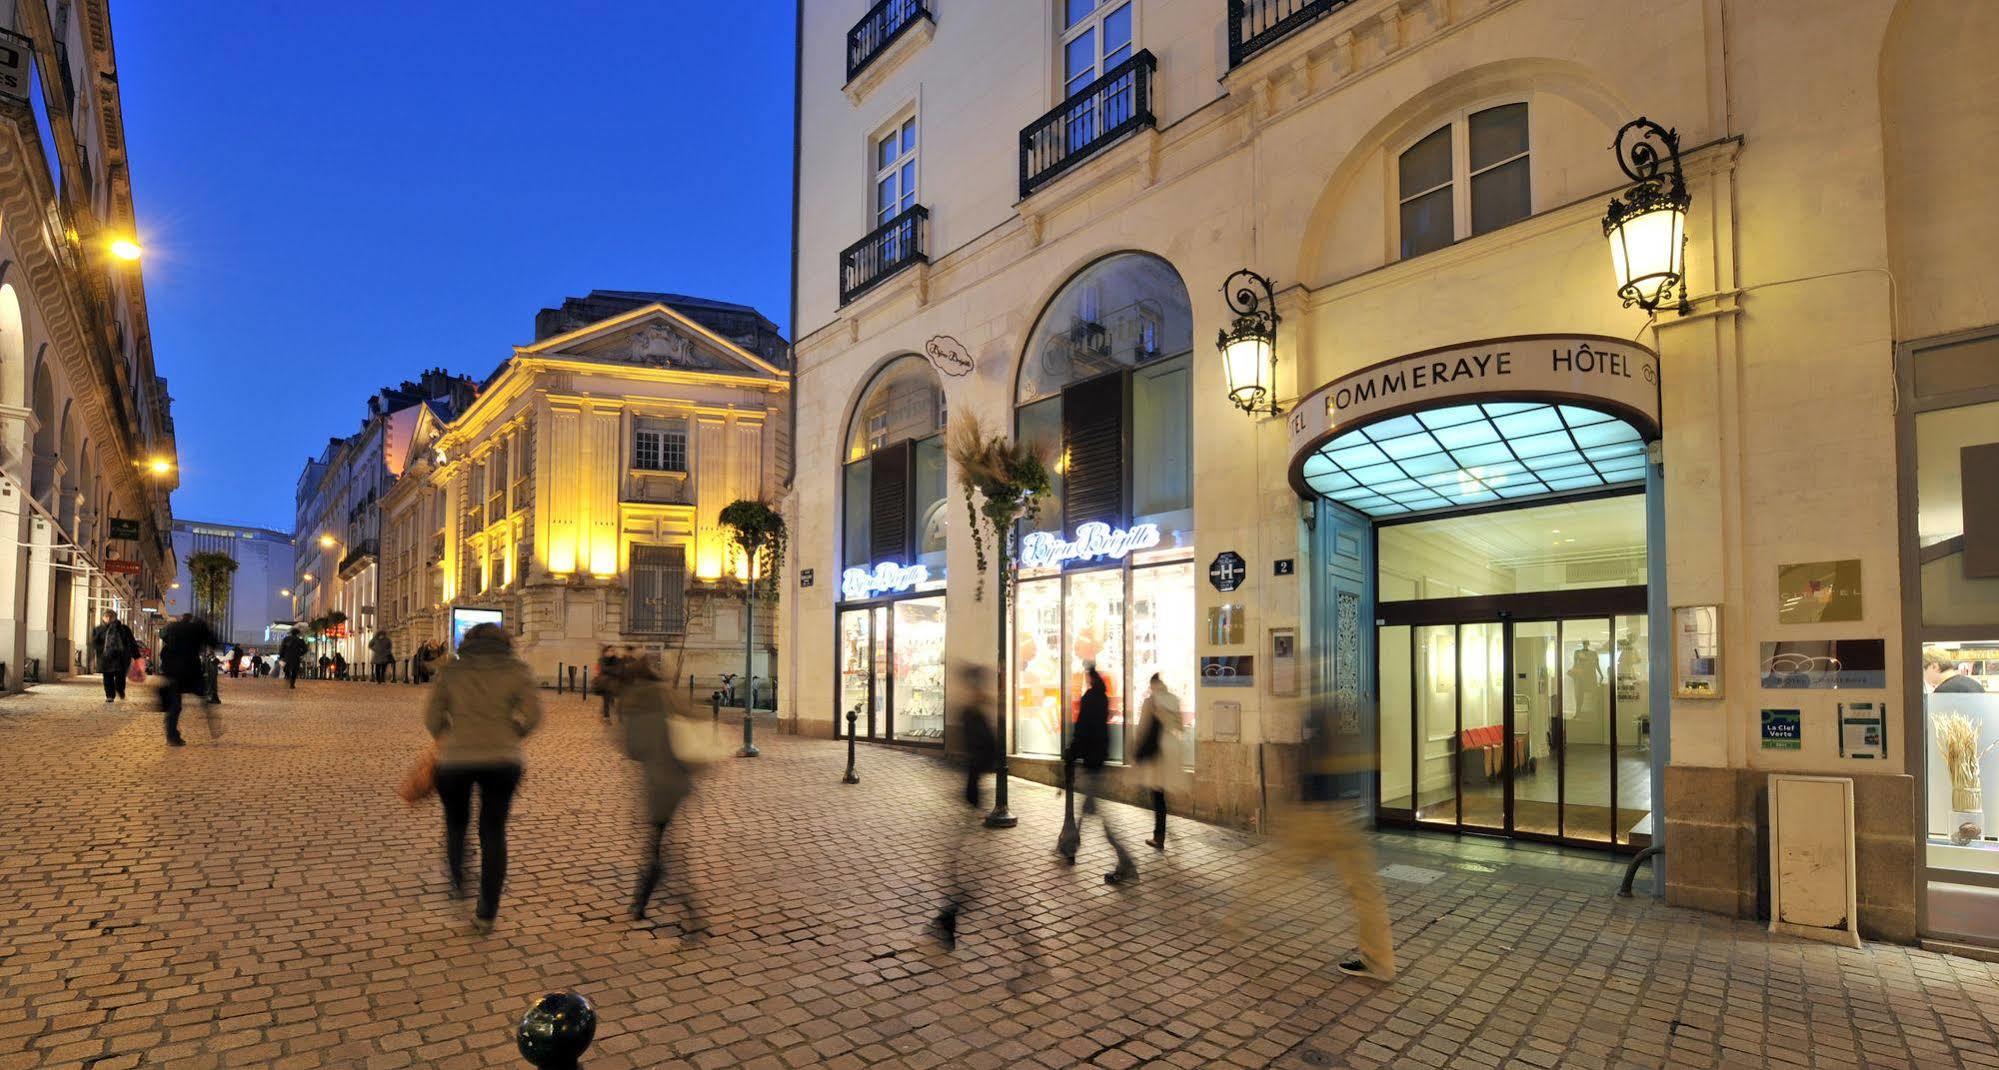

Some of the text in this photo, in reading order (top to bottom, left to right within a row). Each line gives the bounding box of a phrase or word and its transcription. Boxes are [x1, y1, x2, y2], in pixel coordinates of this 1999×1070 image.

[1324, 352, 1511, 417] POMMERAYE
[1552, 343, 1632, 378] HÔTEL
[1220, 563, 1234, 580] H
[1280, 561, 1288, 573] 2
[1778, 724, 1795, 732] Clef
